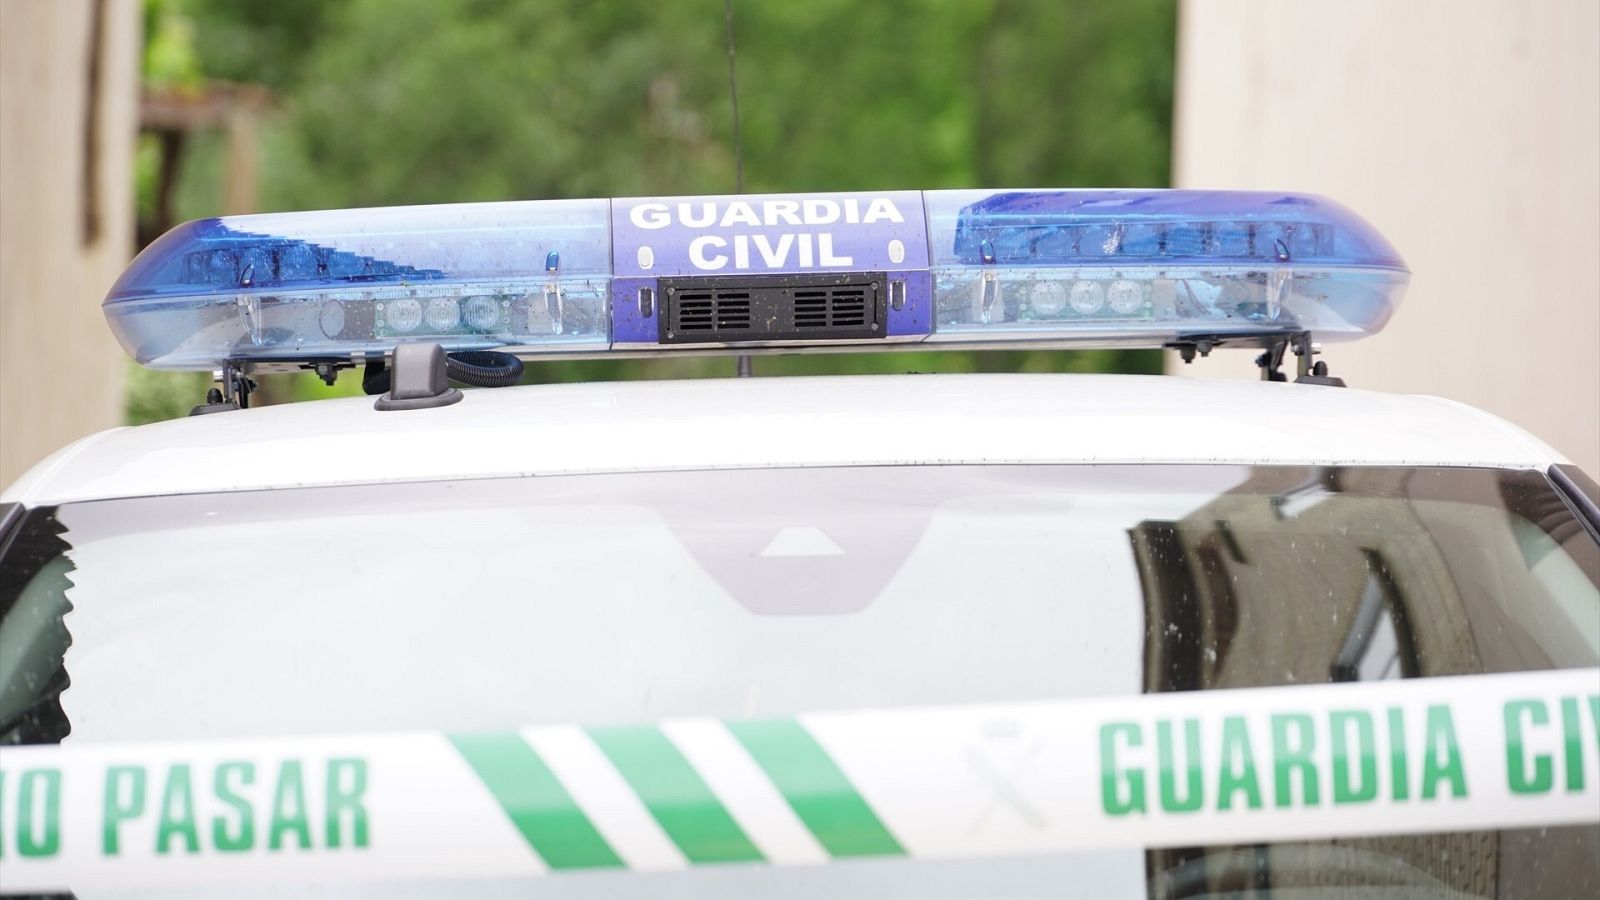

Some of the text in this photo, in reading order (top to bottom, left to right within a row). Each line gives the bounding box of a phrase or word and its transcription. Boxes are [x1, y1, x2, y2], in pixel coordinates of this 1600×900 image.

[629, 197, 905, 229] GUARDIA
[688, 232, 853, 270] CIVIL
[1098, 694, 1600, 816] GUARDIA CI
[0, 757, 370, 858] O PASAR
